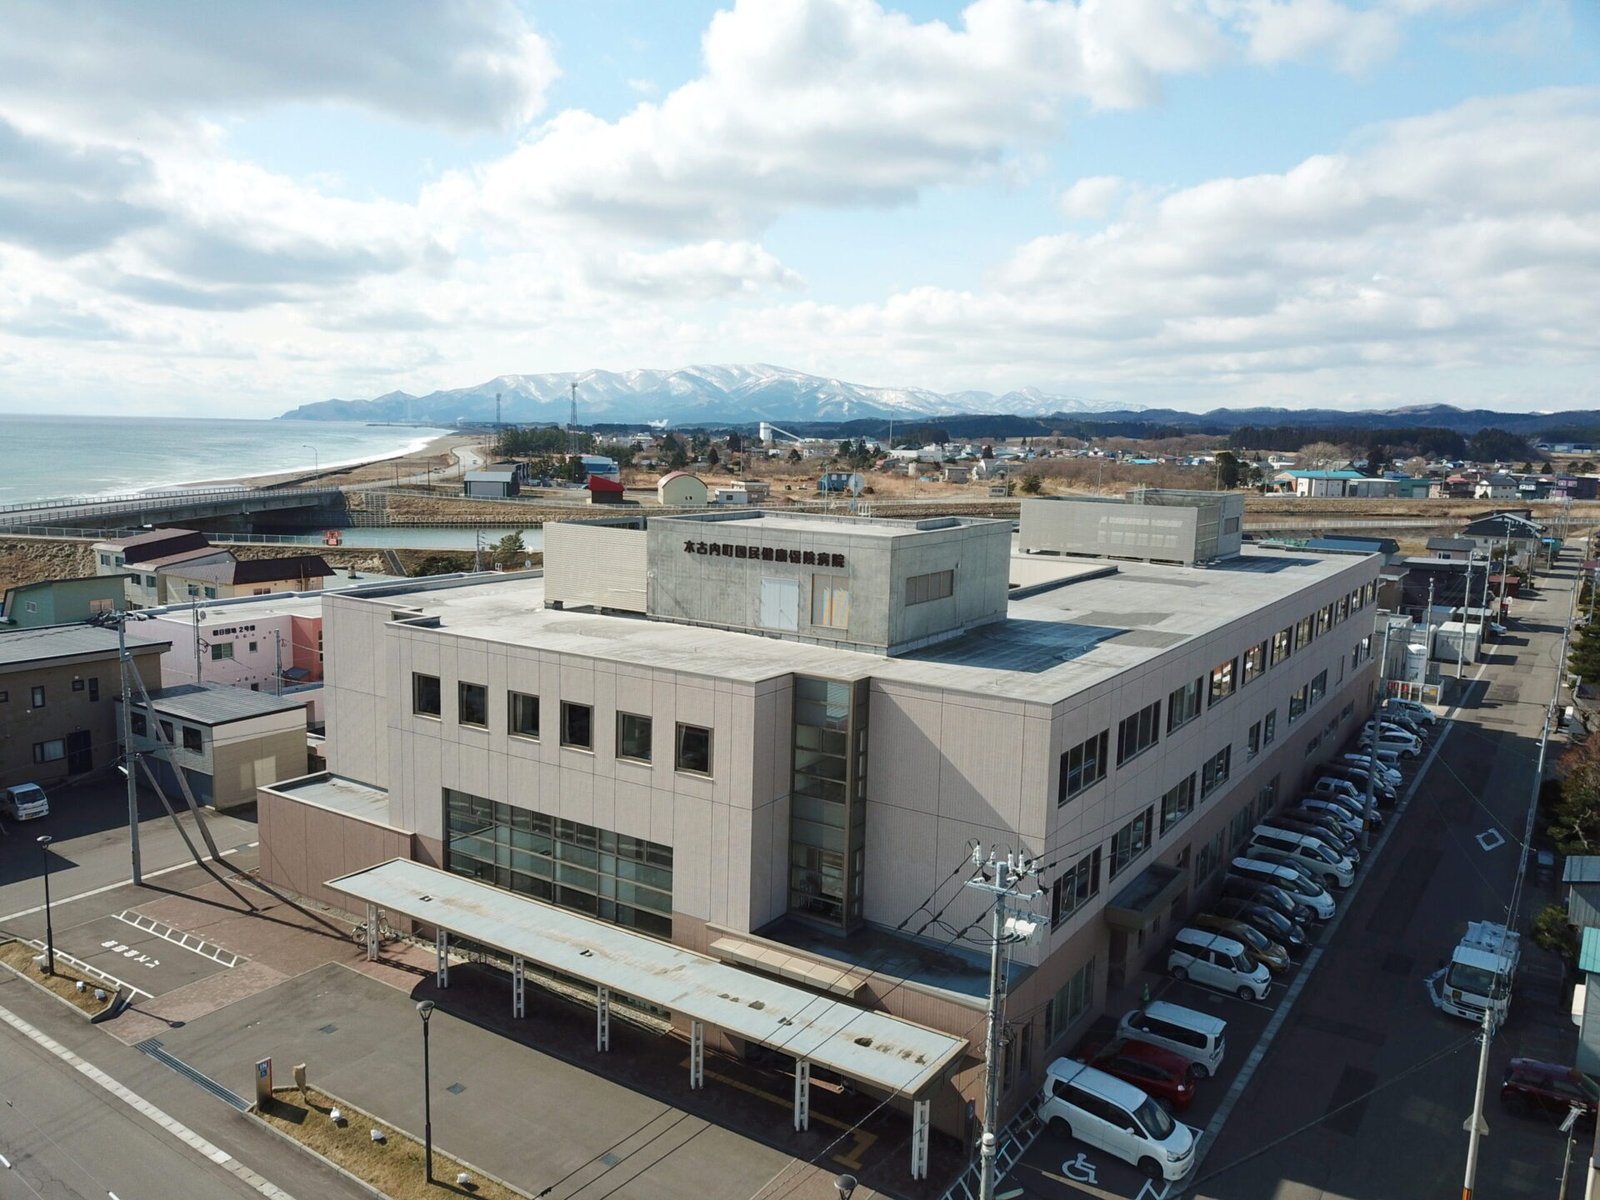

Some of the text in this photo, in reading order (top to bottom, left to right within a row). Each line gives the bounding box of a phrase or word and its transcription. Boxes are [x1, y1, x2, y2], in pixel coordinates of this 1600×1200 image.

[684, 540, 845, 568] 木古内町国民健康保険病院
